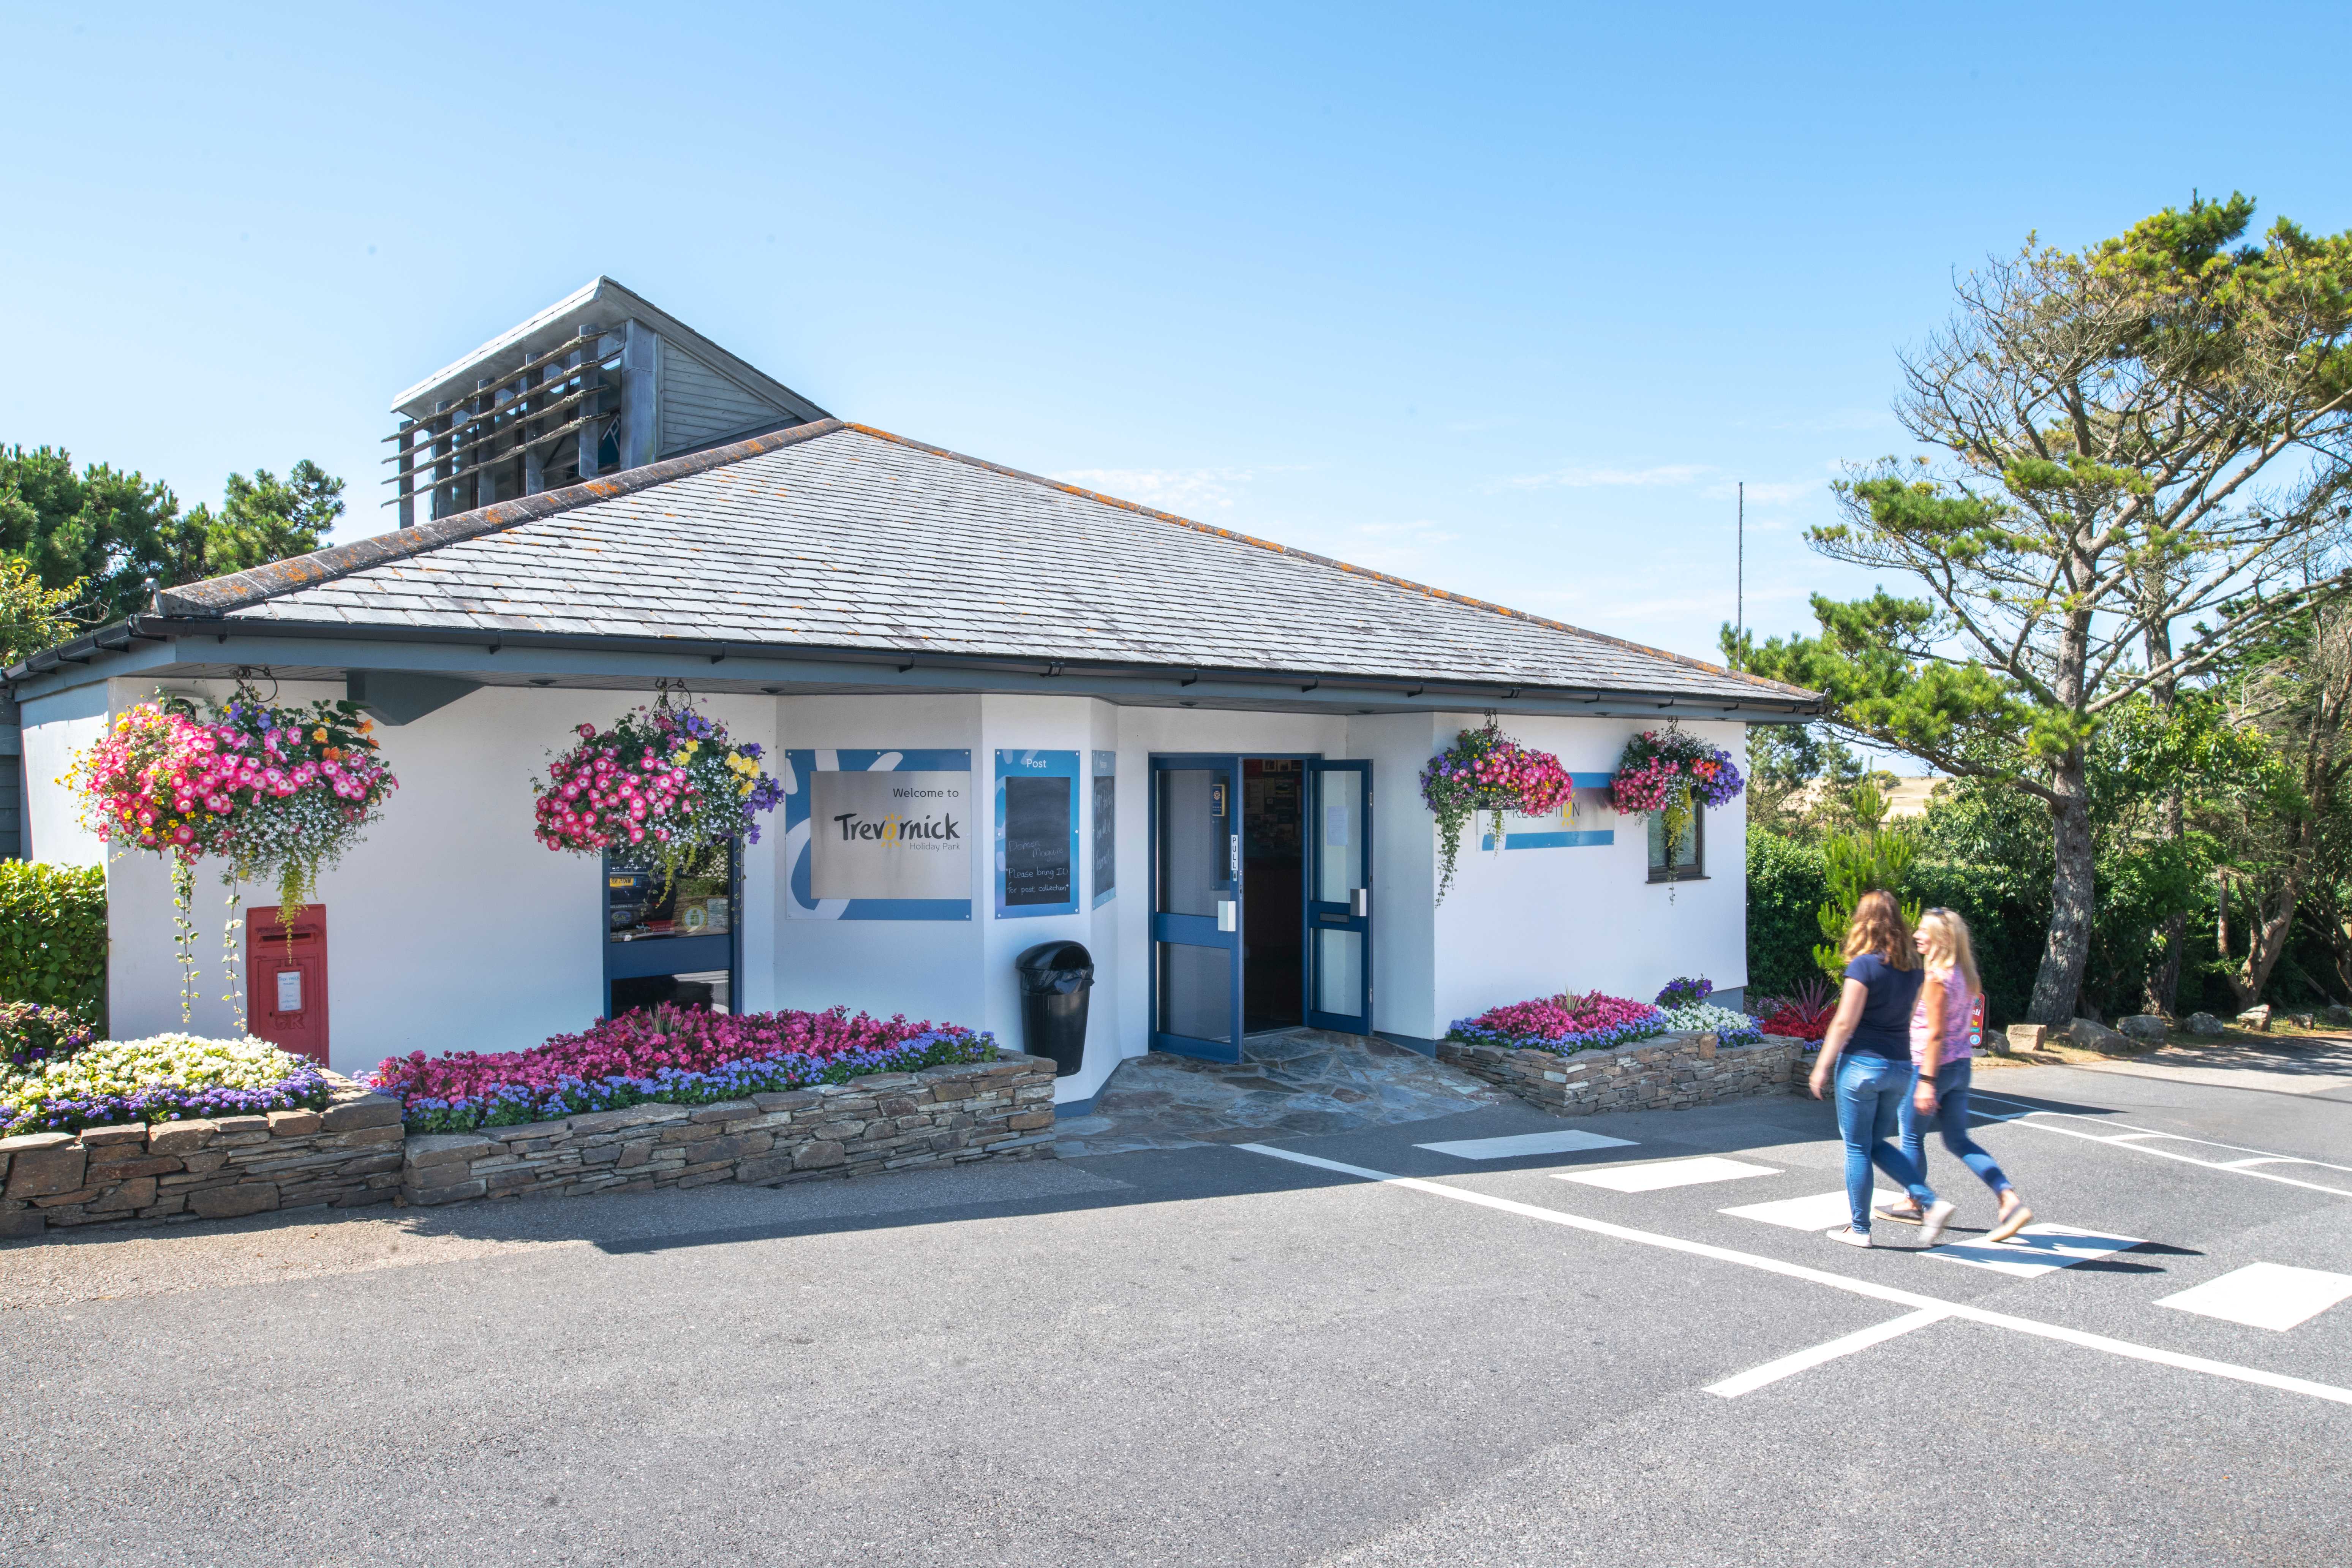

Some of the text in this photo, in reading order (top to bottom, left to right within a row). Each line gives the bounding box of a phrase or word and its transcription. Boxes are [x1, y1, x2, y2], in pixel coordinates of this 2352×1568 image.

[1027, 759, 1046, 768] Post
[893, 788, 959, 797] Welcome to
[834, 812, 961, 841] Trevornick
[910, 842, 940, 852] Holiday
[1008, 840, 1041, 852] Doreen
[1037, 866, 1054, 879] bring
[1007, 882, 1017, 893] for
[1021, 885, 1036, 896] post
